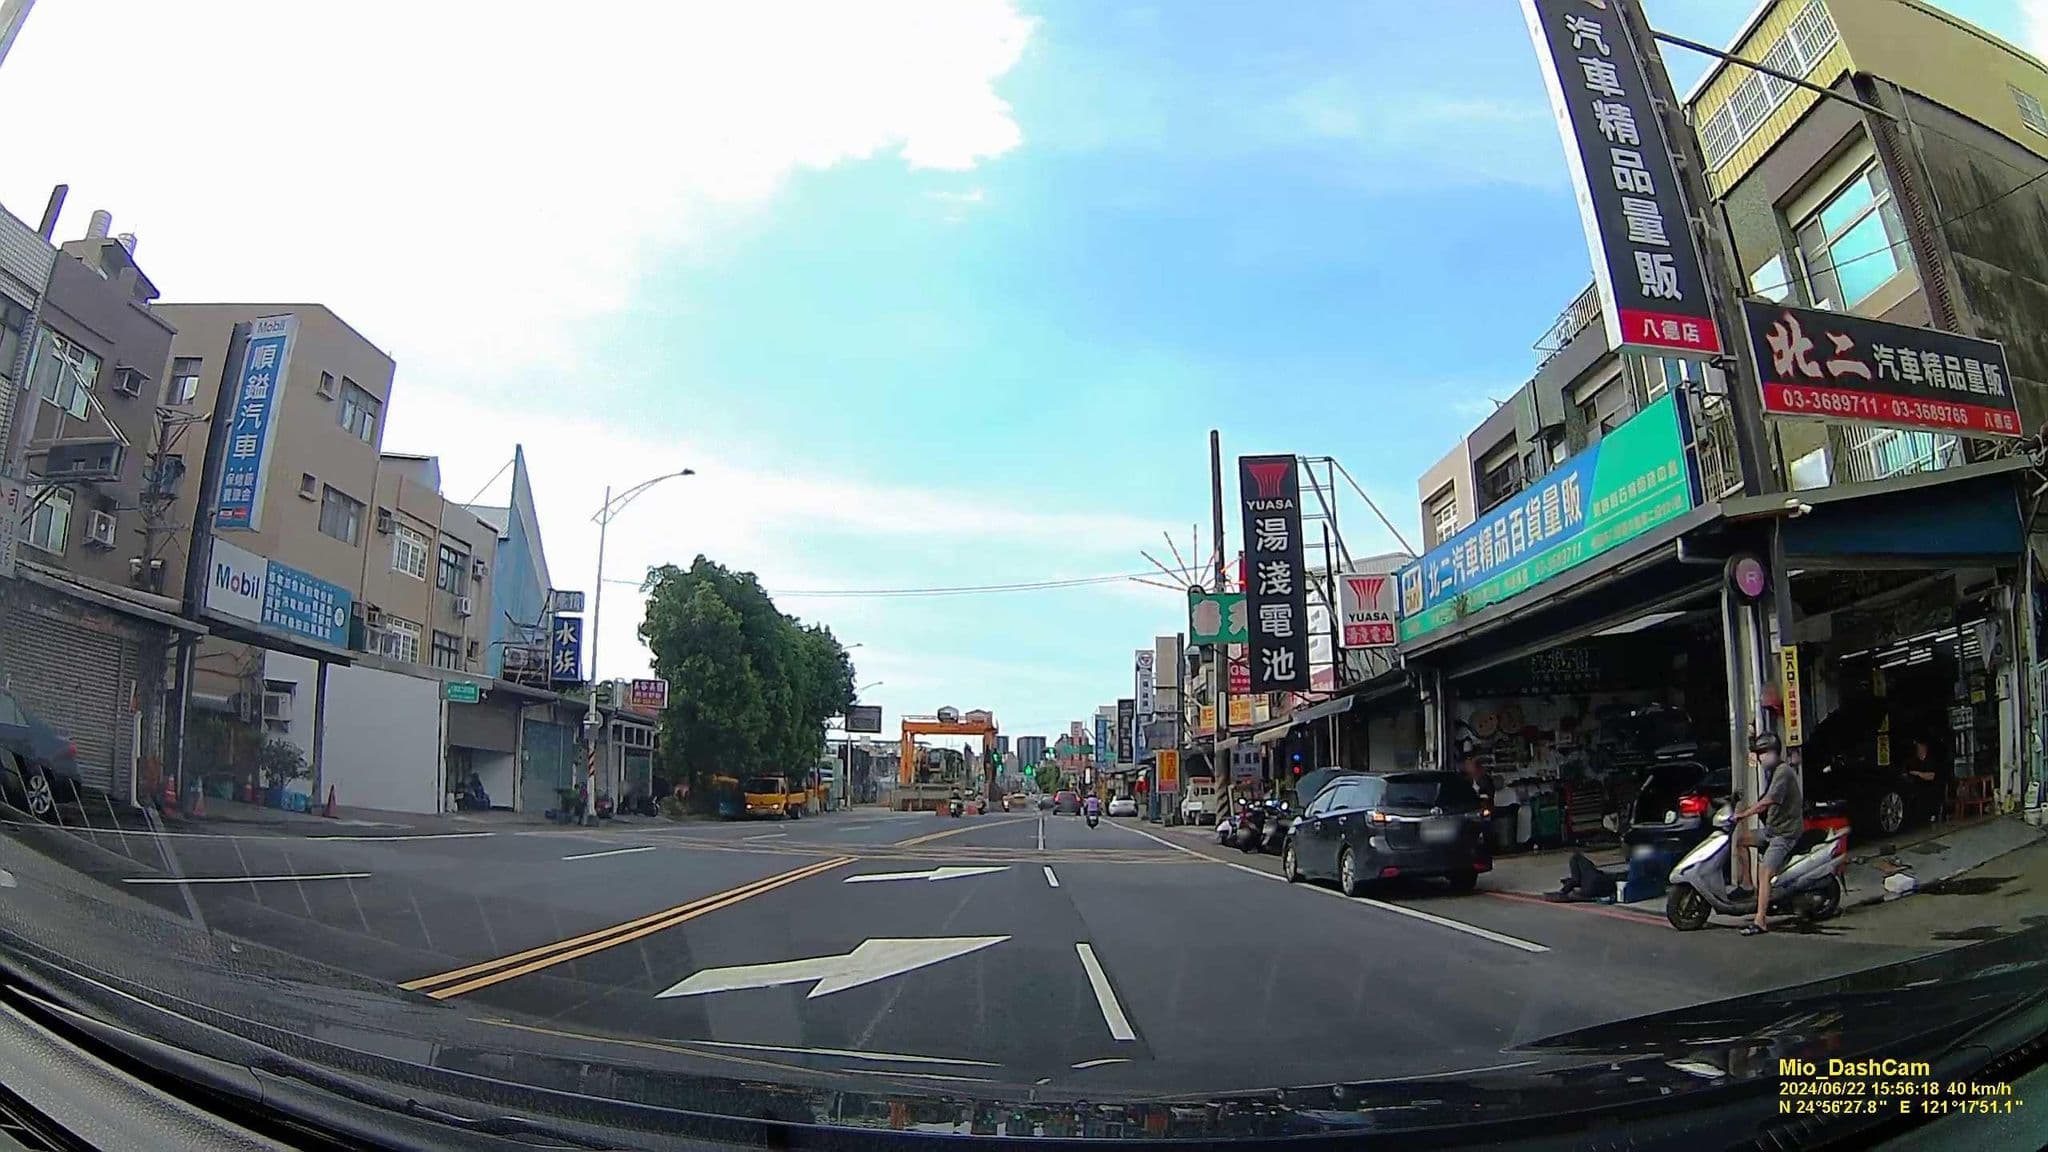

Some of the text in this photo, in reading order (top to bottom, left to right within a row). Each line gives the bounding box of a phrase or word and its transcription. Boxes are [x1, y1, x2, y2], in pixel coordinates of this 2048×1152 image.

[1871, 343, 2007, 398] 汽車精品量販
[1782, 388, 1878, 415] 03-3689711
[1891, 398, 1968, 426] 03-3689766
[1246, 499, 1293, 511] YUASA
[216, 563, 260, 599] Mobil
[1255, 517, 1296, 682] 湯淺電池
[1349, 612, 1389, 623] YUASA
[555, 621, 577, 674] 水族
